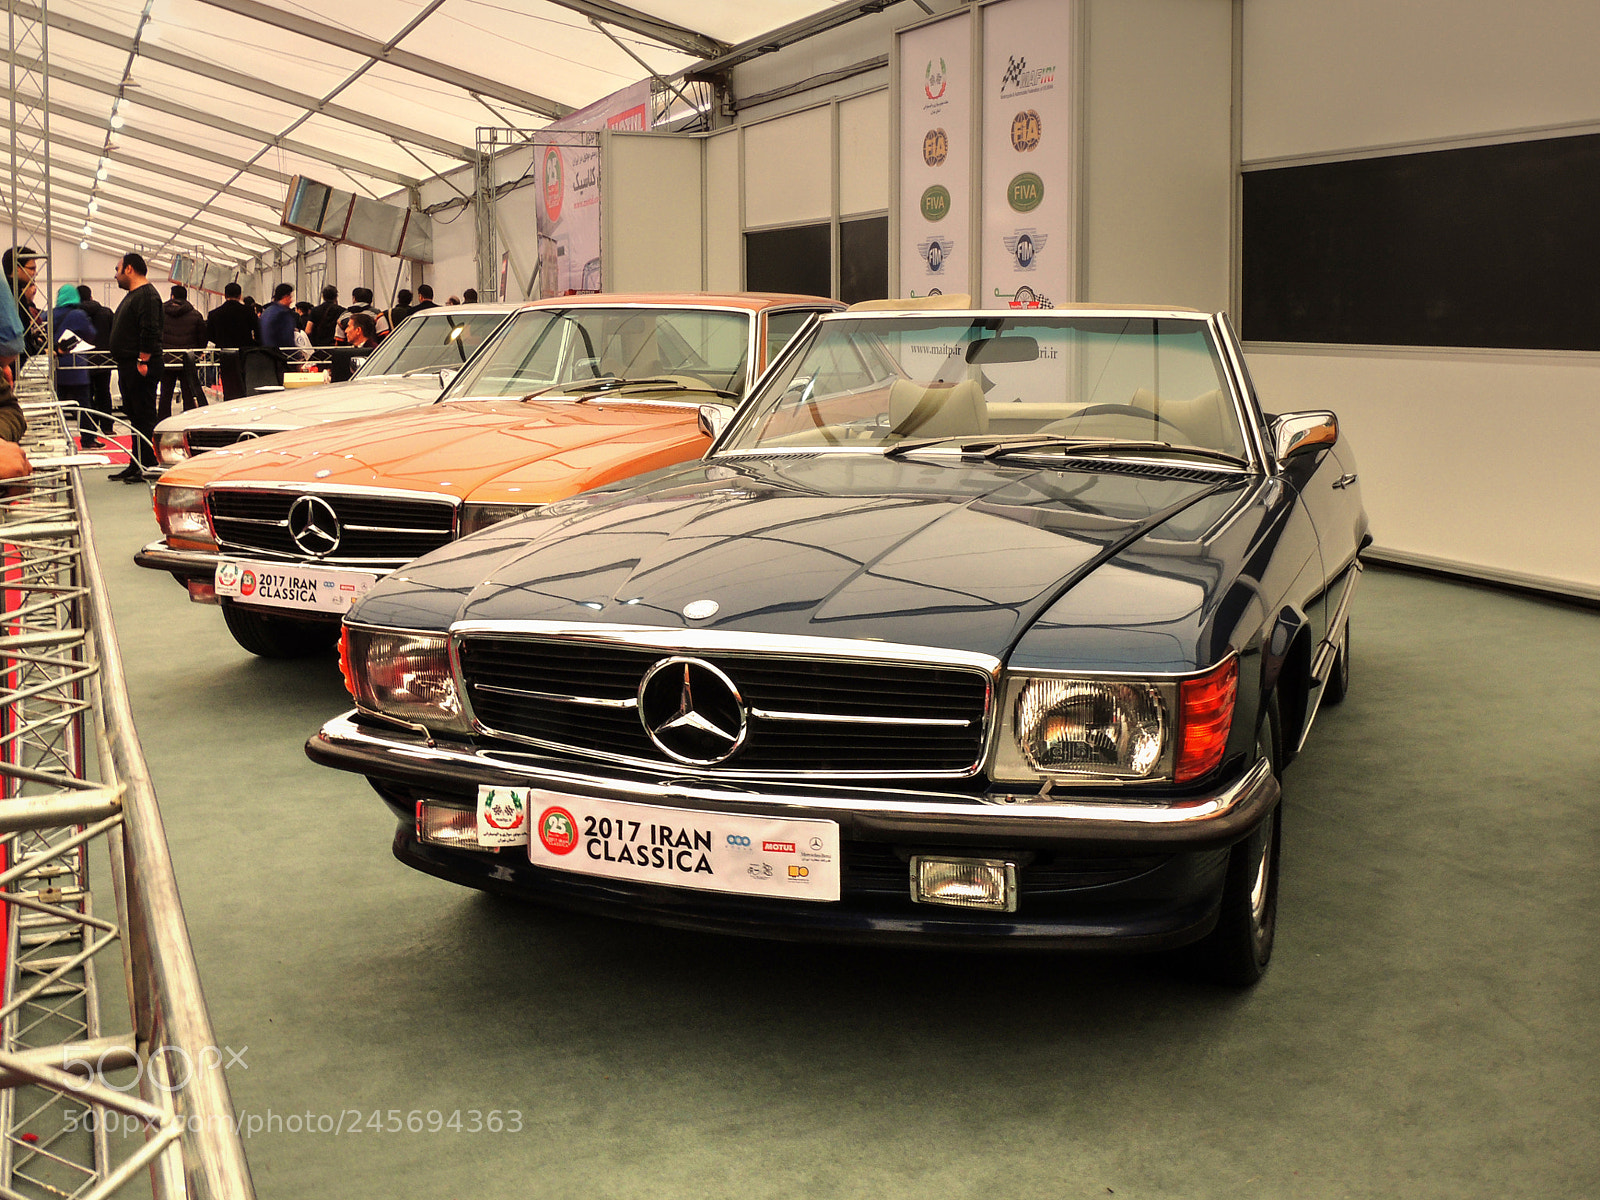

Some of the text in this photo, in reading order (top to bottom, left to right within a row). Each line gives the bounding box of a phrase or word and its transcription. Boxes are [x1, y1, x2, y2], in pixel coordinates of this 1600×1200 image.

[1013, 118, 1038, 142] FIA
[925, 135, 946, 157] FIA
[1014, 184, 1037, 200] FIVA
[926, 196, 945, 210] FIVA
[928, 248, 942, 266] FIM
[1017, 241, 1034, 261] FIM
[259, 573, 317, 591] 2017 IRAN
[259, 585, 317, 603] CLASSICA
[548, 815, 568, 835] 25
[584, 815, 712, 853] 2017 IRAN
[764, 842, 794, 851] MOTUL
[586, 838, 714, 875] CLASSICA
